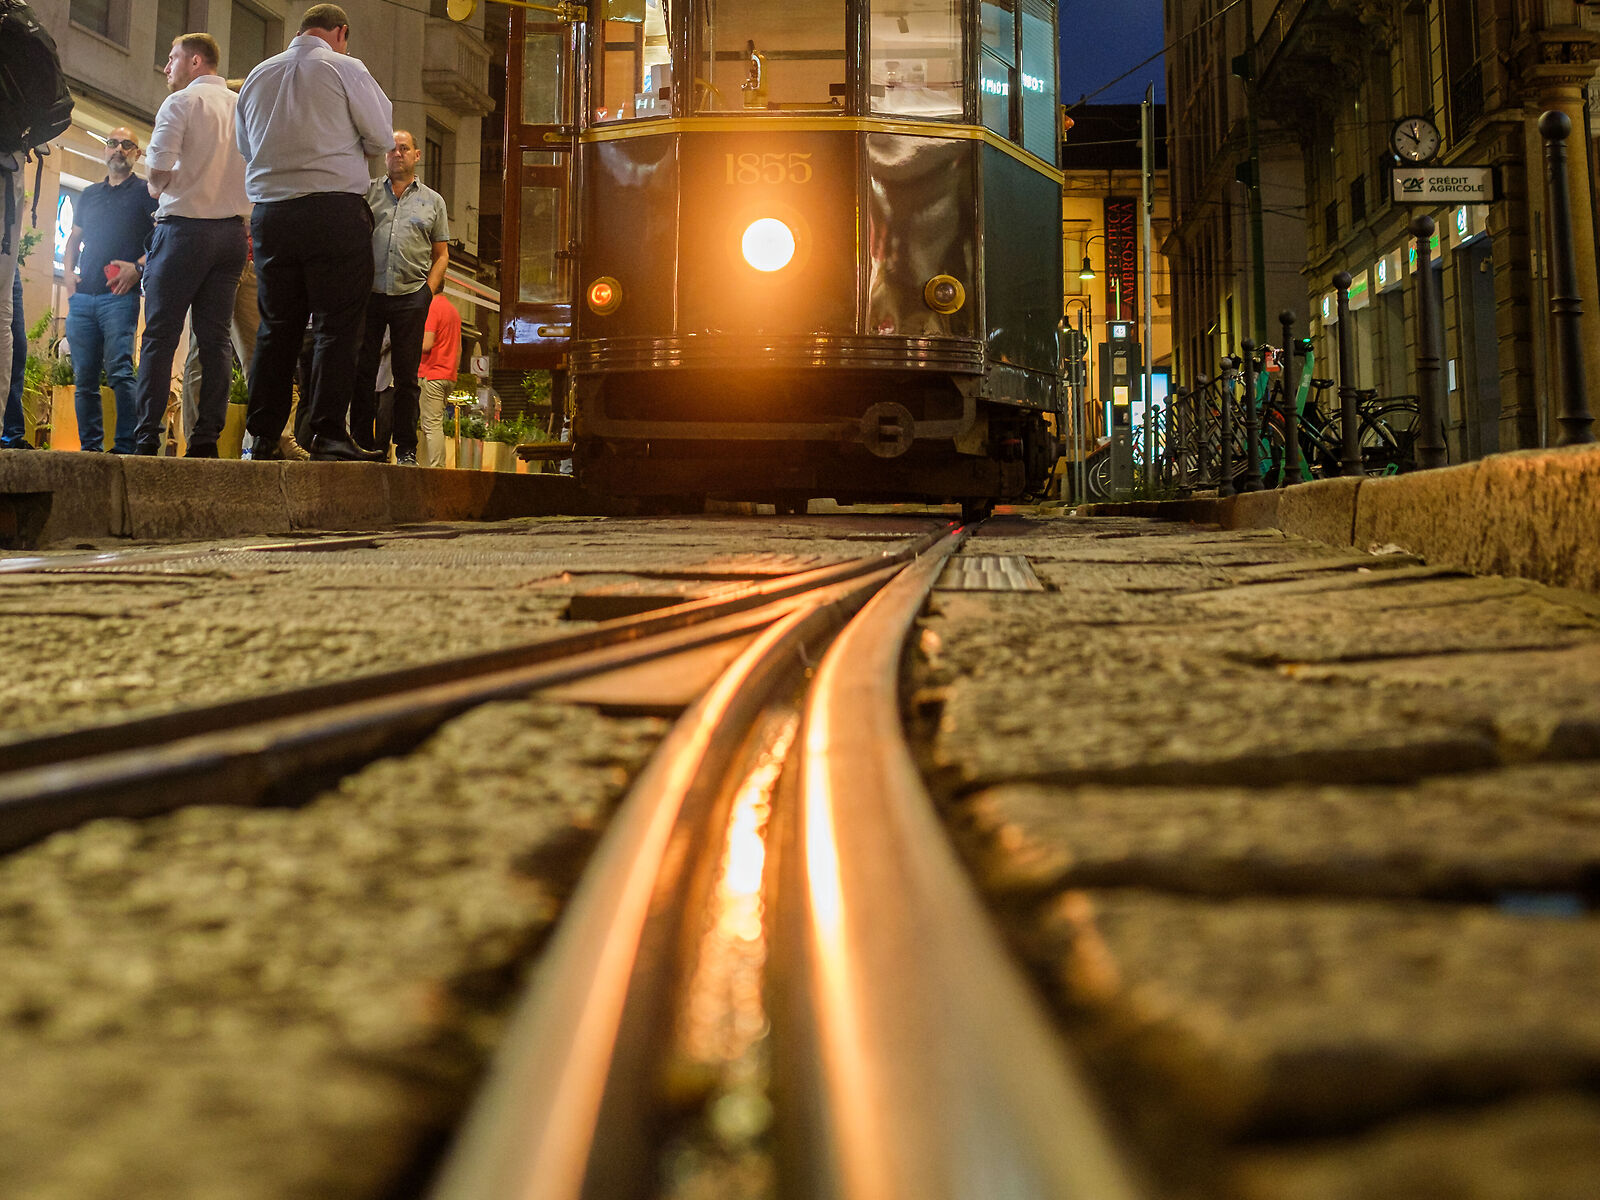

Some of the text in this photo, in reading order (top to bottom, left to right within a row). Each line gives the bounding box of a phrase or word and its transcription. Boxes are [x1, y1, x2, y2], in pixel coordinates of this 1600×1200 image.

[725, 152, 813, 185] 1855
[1428, 175, 1469, 185] CRÉDIT
[1429, 184, 1485, 193] AGRICOLE
[1121, 202, 1135, 305] AMBROSIANA
